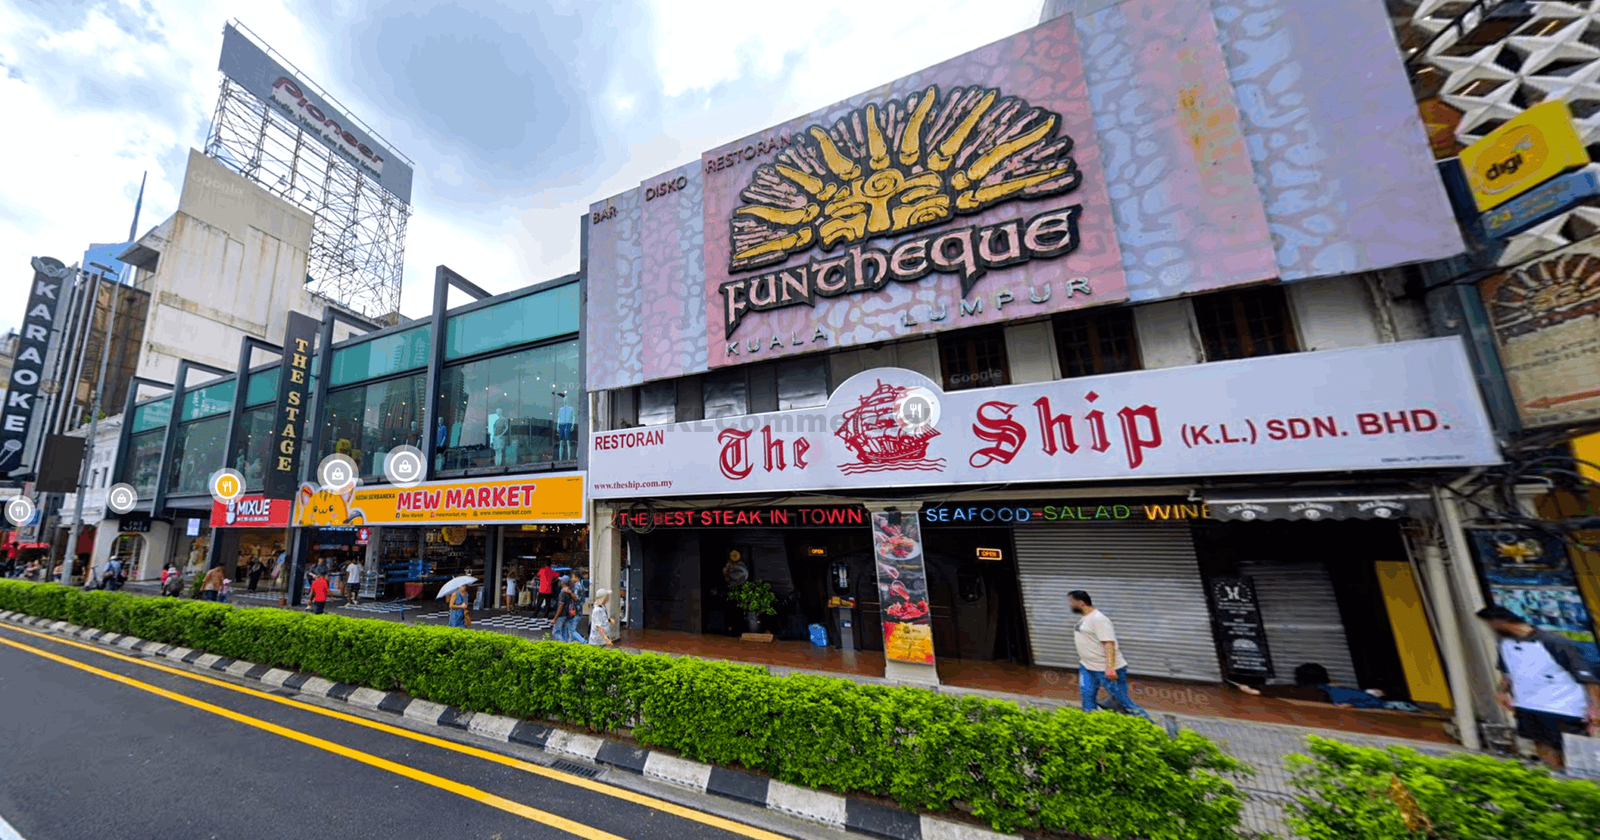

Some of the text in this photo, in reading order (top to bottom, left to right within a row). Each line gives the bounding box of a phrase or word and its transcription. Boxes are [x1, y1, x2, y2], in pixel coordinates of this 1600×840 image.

[272, 76, 384, 163] Pioneer
[705, 132, 792, 174] RESTORAN
[644, 175, 688, 202] DISKO
[592, 206, 618, 225] BAR
[725, 277, 1093, 357] KUALA LUMPUR
[4, 280, 57, 433] KARAOKE
[277, 337, 308, 472] THE STAGE
[594, 429, 664, 450] RESTORAN
[717, 390, 1452, 481] The Ship (K.L.) SDN. BHD.
[396, 484, 536, 511] MEW MARKET
[594, 478, 674, 491] www.theship.com.my
[237, 499, 271, 515] MIXUE
[619, 508, 862, 526] THE BEST STEAK IN TOWN
